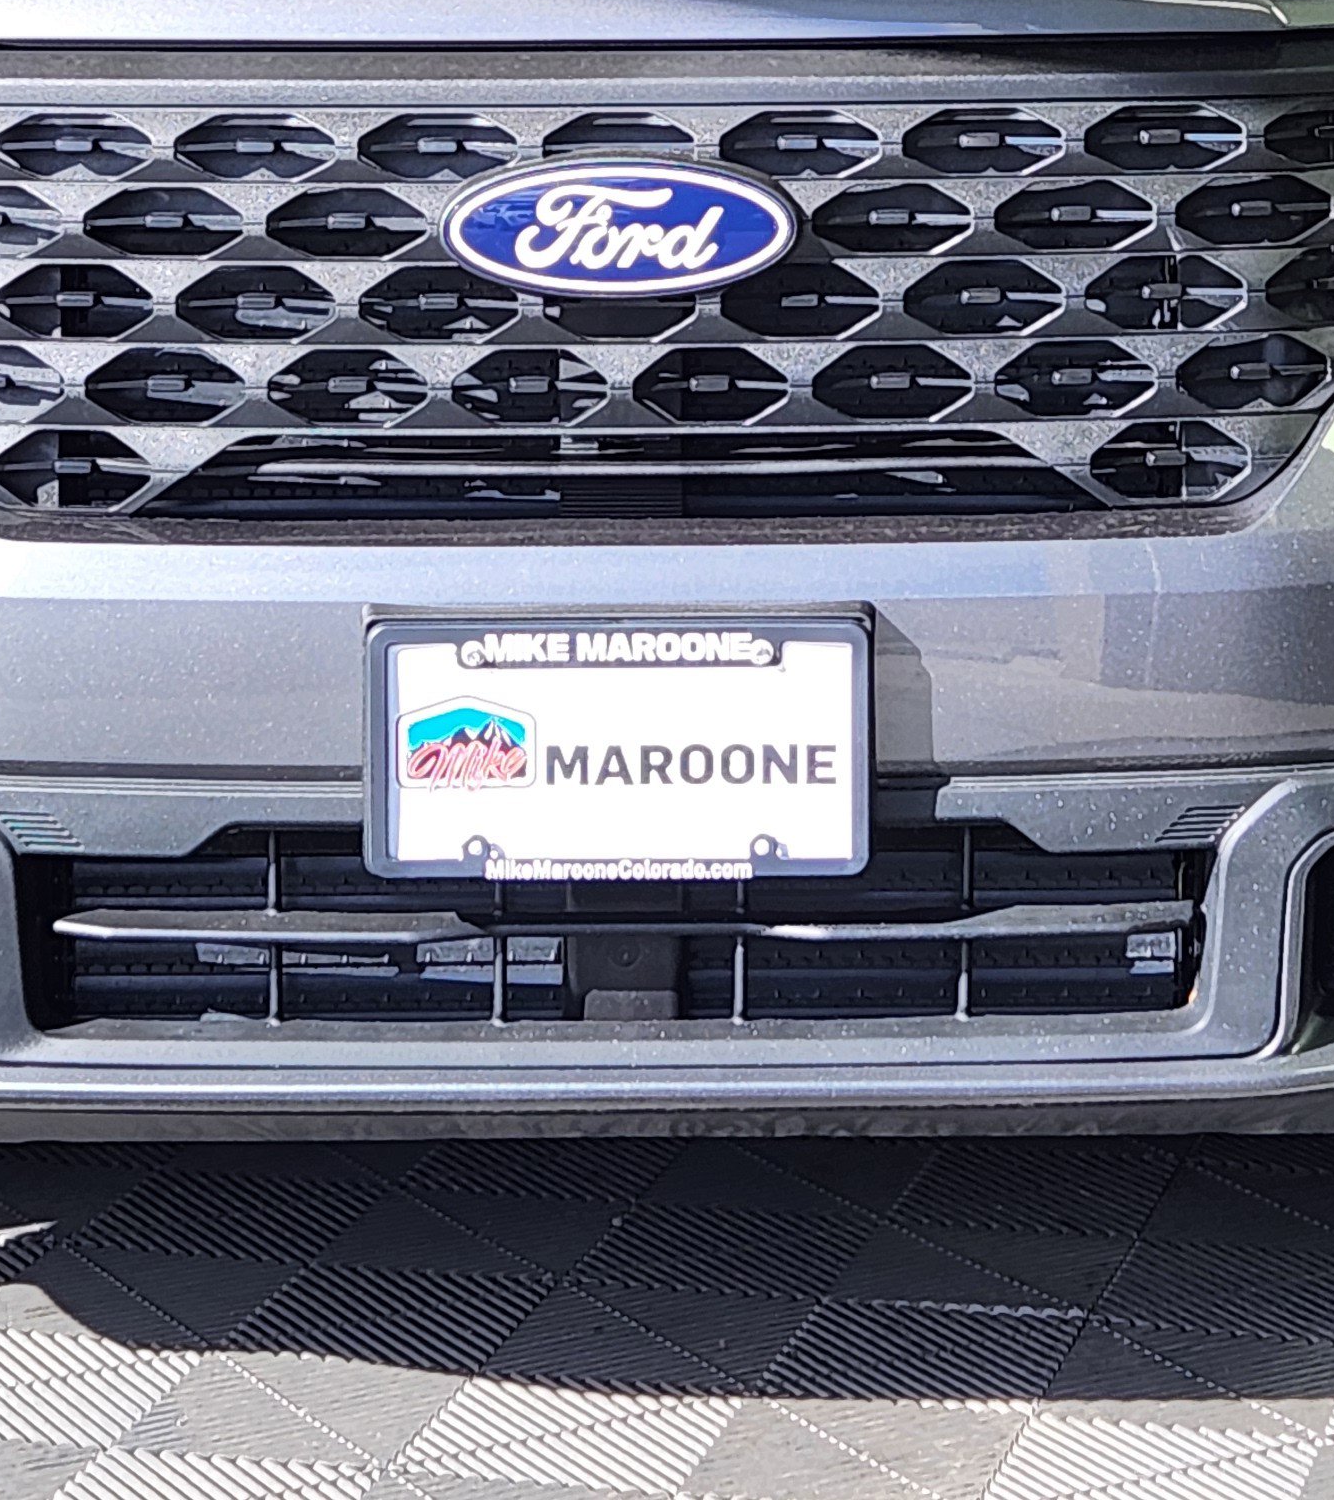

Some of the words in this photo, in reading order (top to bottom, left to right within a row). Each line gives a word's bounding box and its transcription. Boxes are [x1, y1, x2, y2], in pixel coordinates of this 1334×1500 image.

[514, 184, 724, 270] Ford
[483, 632, 570, 663] MIKE
[576, 631, 753, 663] MAROONE
[407, 737, 527, 792] Mike
[546, 743, 837, 786] MAROONE
[485, 858, 754, 881] MikeMarooneColorado.com
